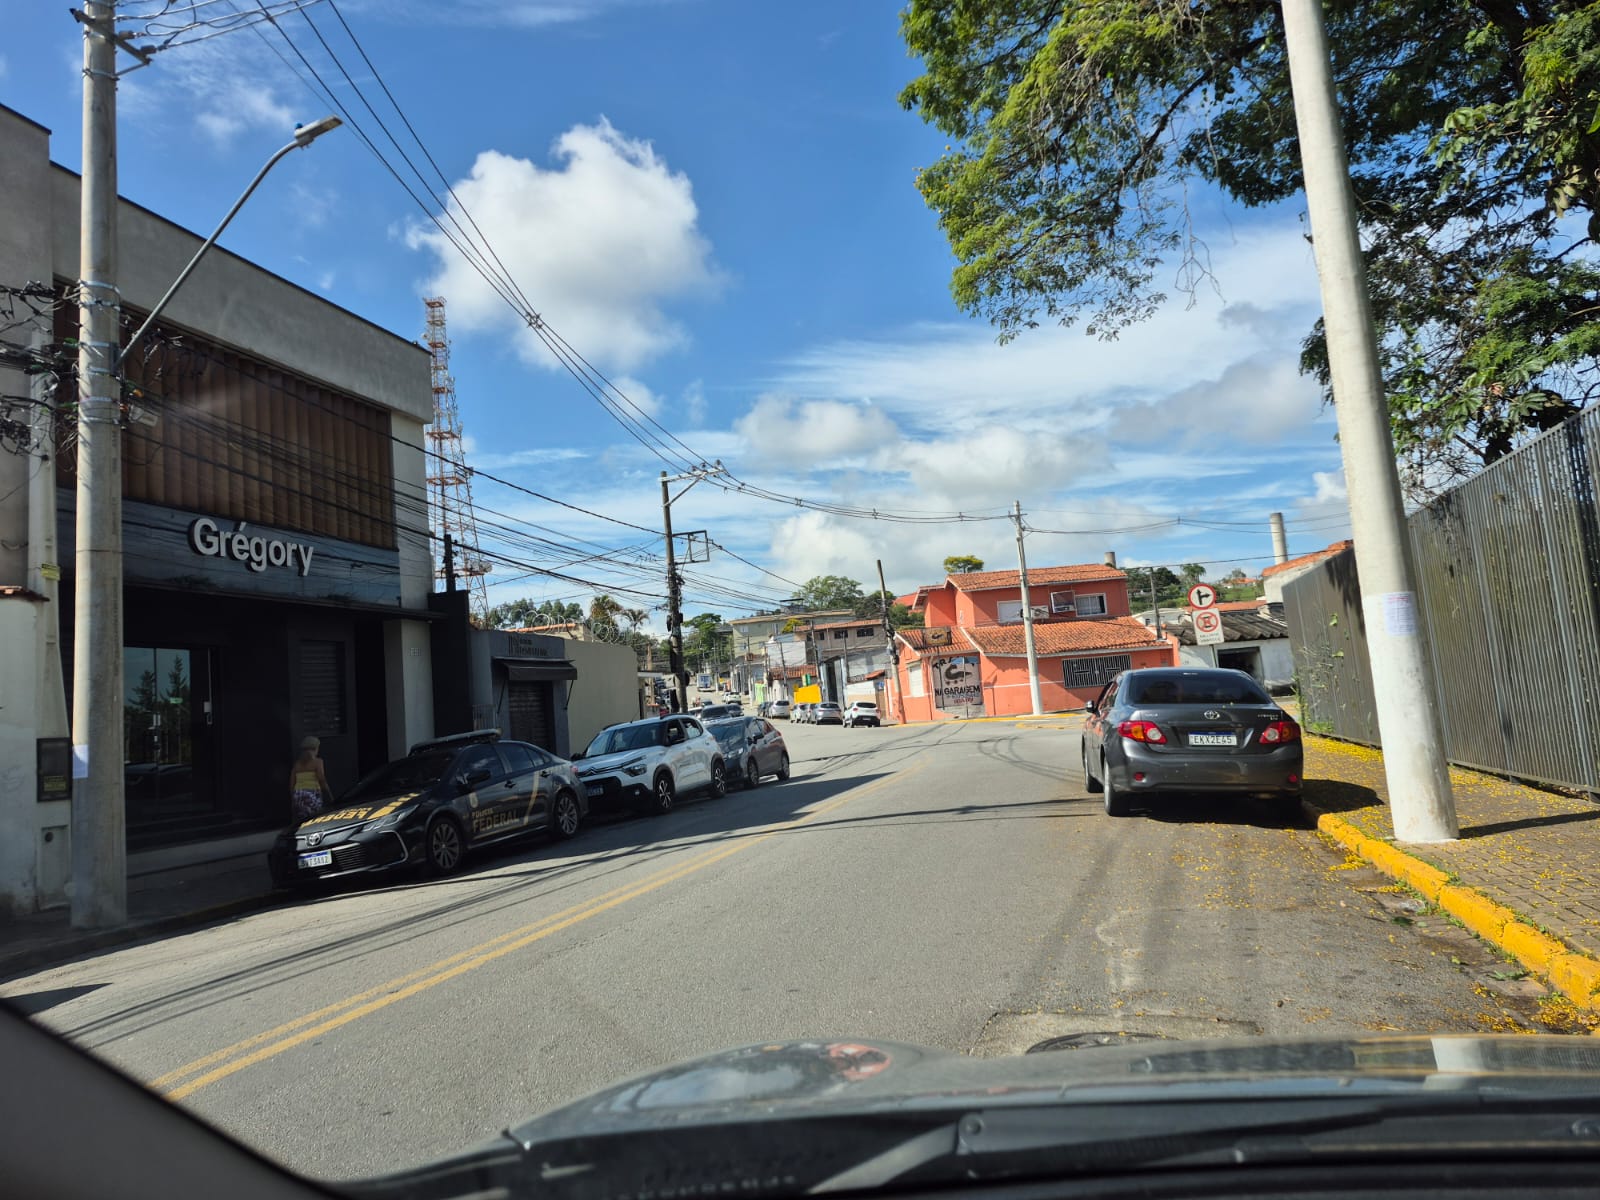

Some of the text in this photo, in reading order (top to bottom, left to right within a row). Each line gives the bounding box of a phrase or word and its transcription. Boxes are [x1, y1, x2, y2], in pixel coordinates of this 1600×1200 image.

[193, 518, 314, 576] Grégory
[1193, 735, 1232, 744] EKX2E45
[472, 809, 520, 833] FEDERAL
